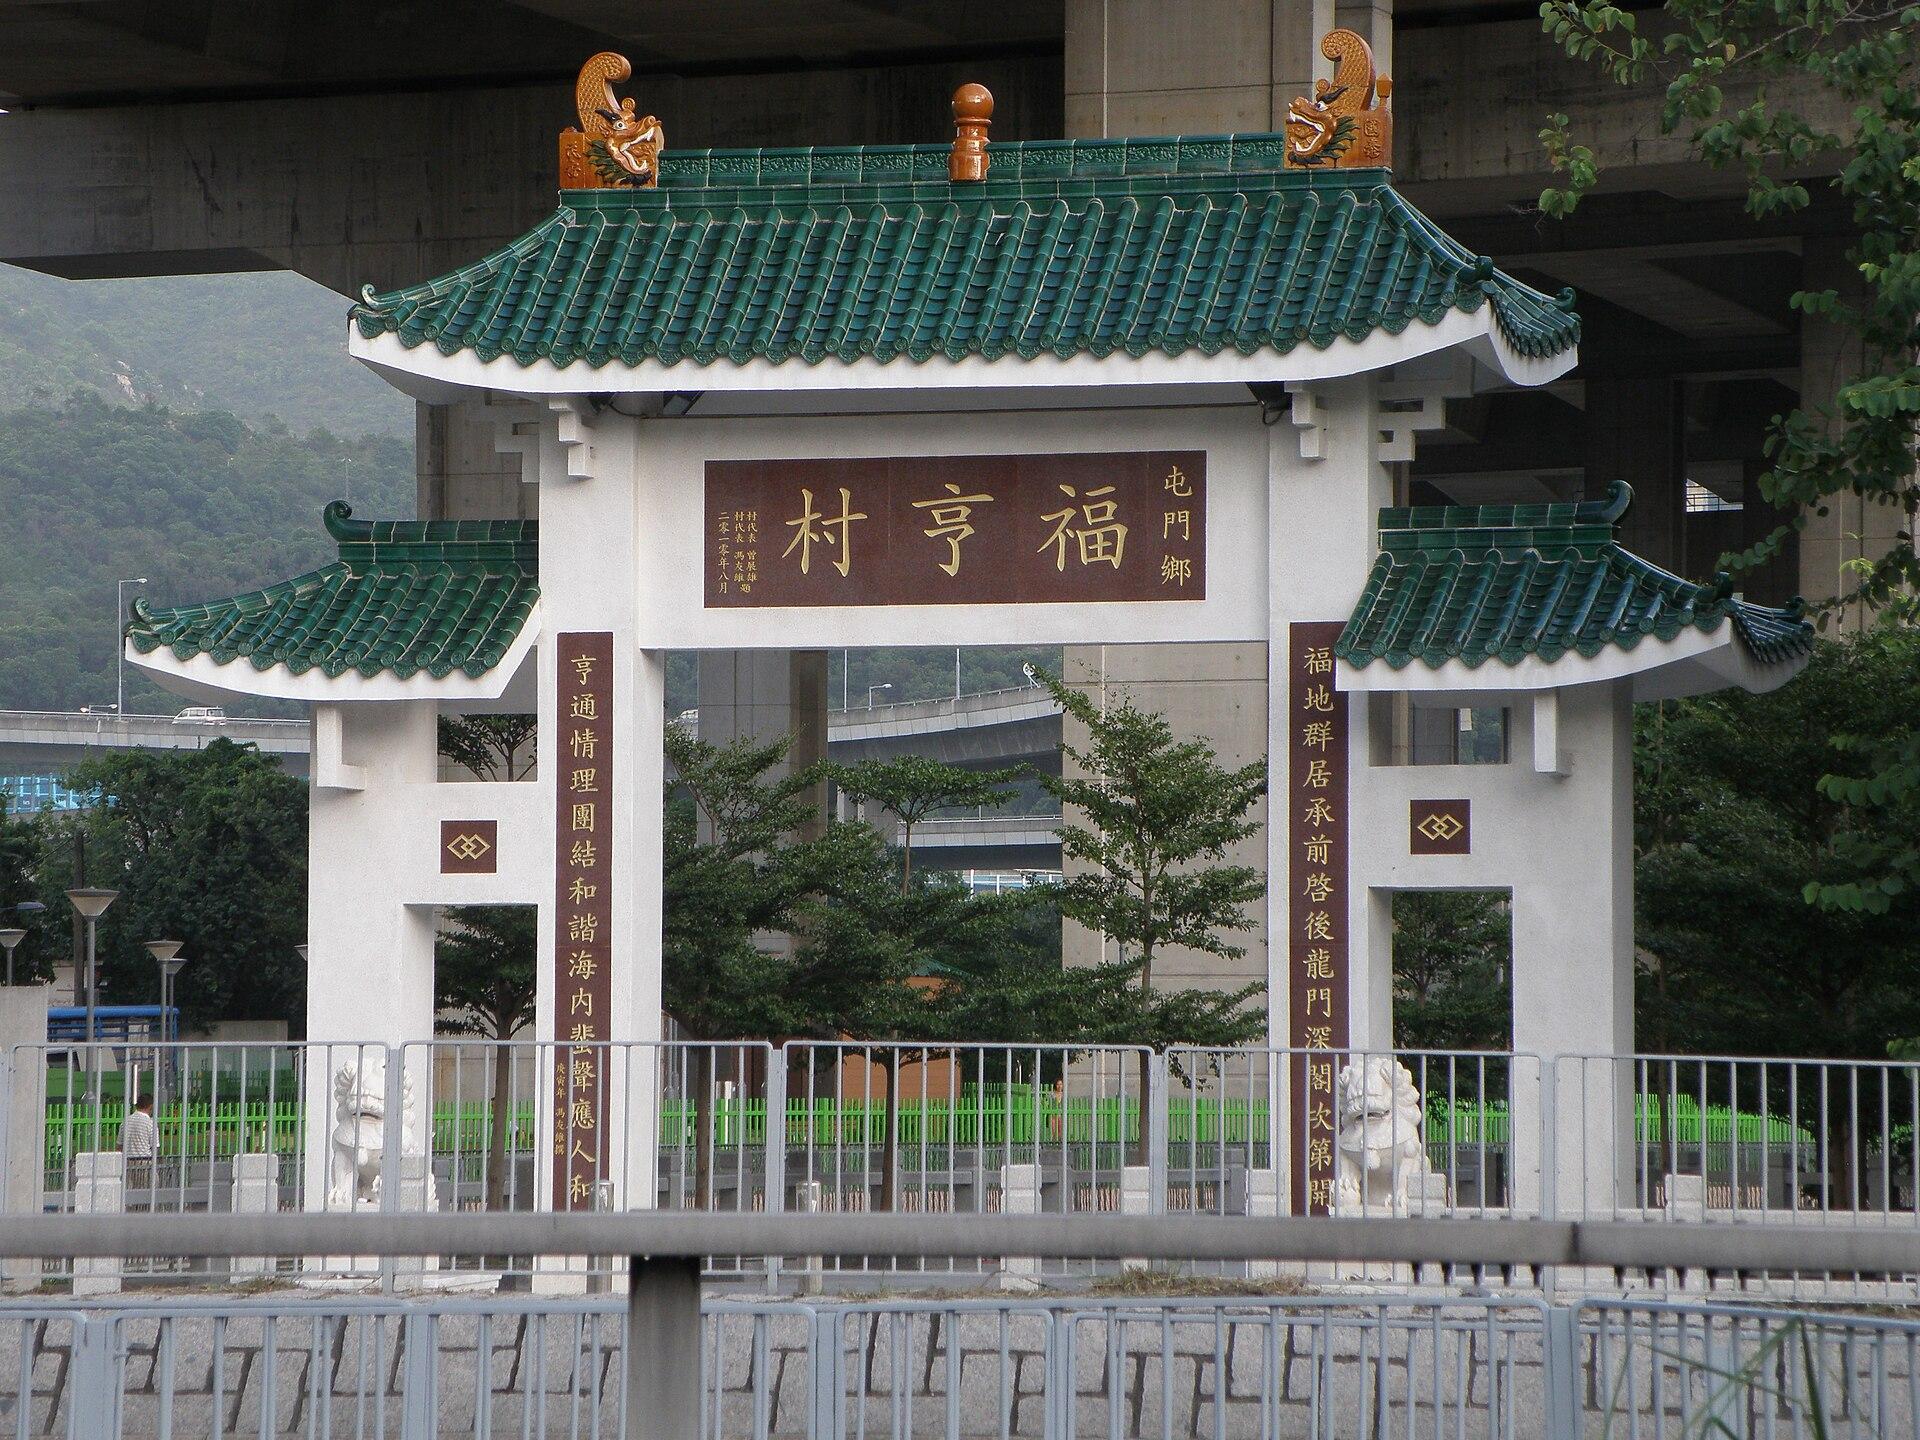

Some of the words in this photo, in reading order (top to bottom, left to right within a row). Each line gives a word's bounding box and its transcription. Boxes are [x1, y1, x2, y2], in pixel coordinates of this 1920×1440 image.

[718, 511, 730, 594] 二零一零年八月
[734, 511, 745, 543] 村代表
[746, 511, 758, 543] 村代表
[780, 483, 1130, 579] 福亨村
[1161, 464, 1193, 588] 屯門鄉
